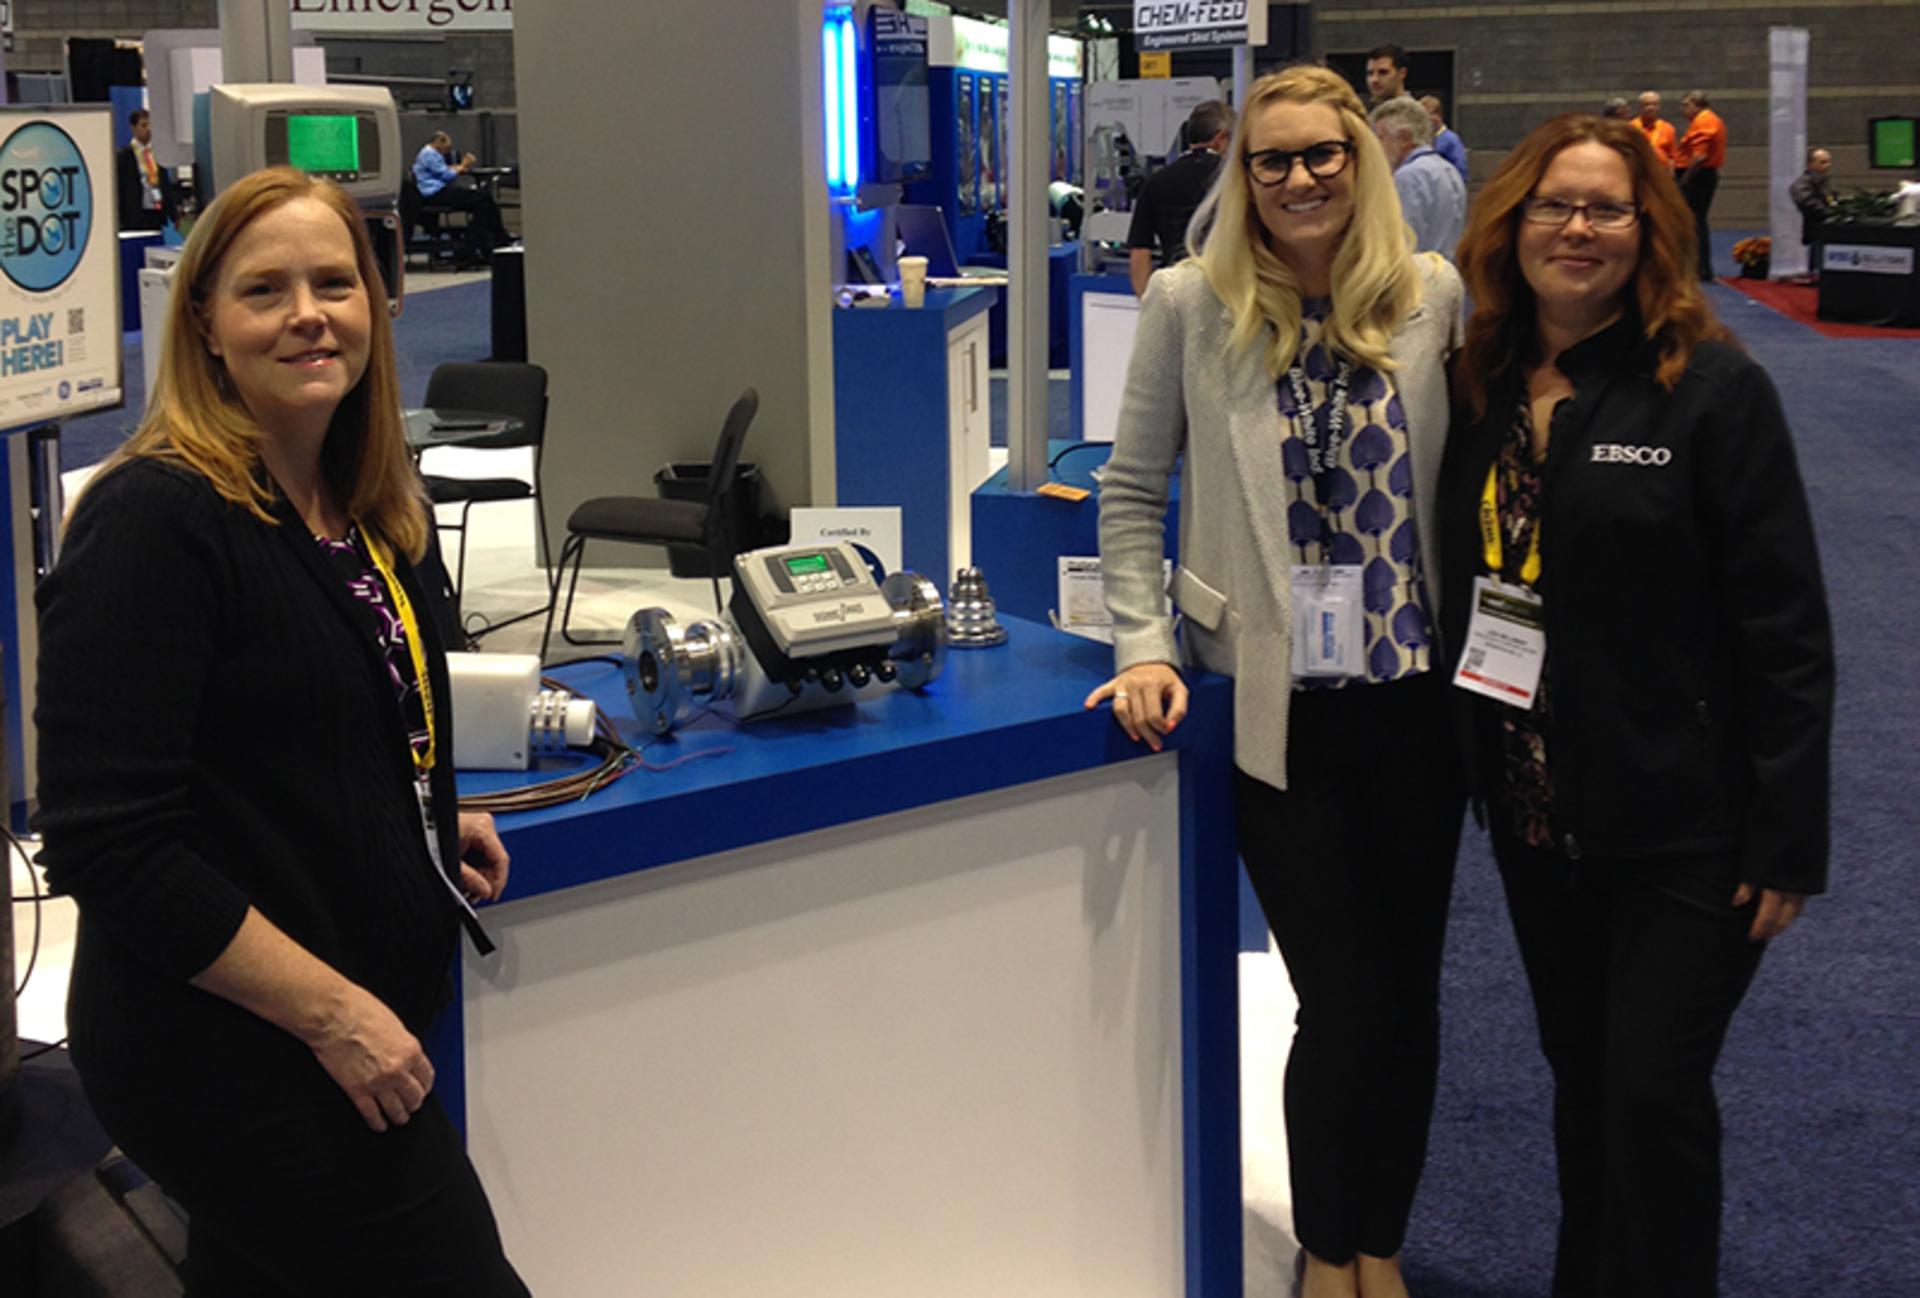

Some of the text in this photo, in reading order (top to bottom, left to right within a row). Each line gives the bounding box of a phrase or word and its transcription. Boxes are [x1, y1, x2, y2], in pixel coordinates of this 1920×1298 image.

[1137, 0, 1247, 28] CHEM-FEED
[1, 167, 80, 212] SPOT
[17, 212, 81, 257] DOT
[1, 312, 54, 347] PLAY
[1, 341, 63, 378] HERE!
[1591, 443, 1672, 466] EBSCO
[820, 528, 857, 536] Certified
